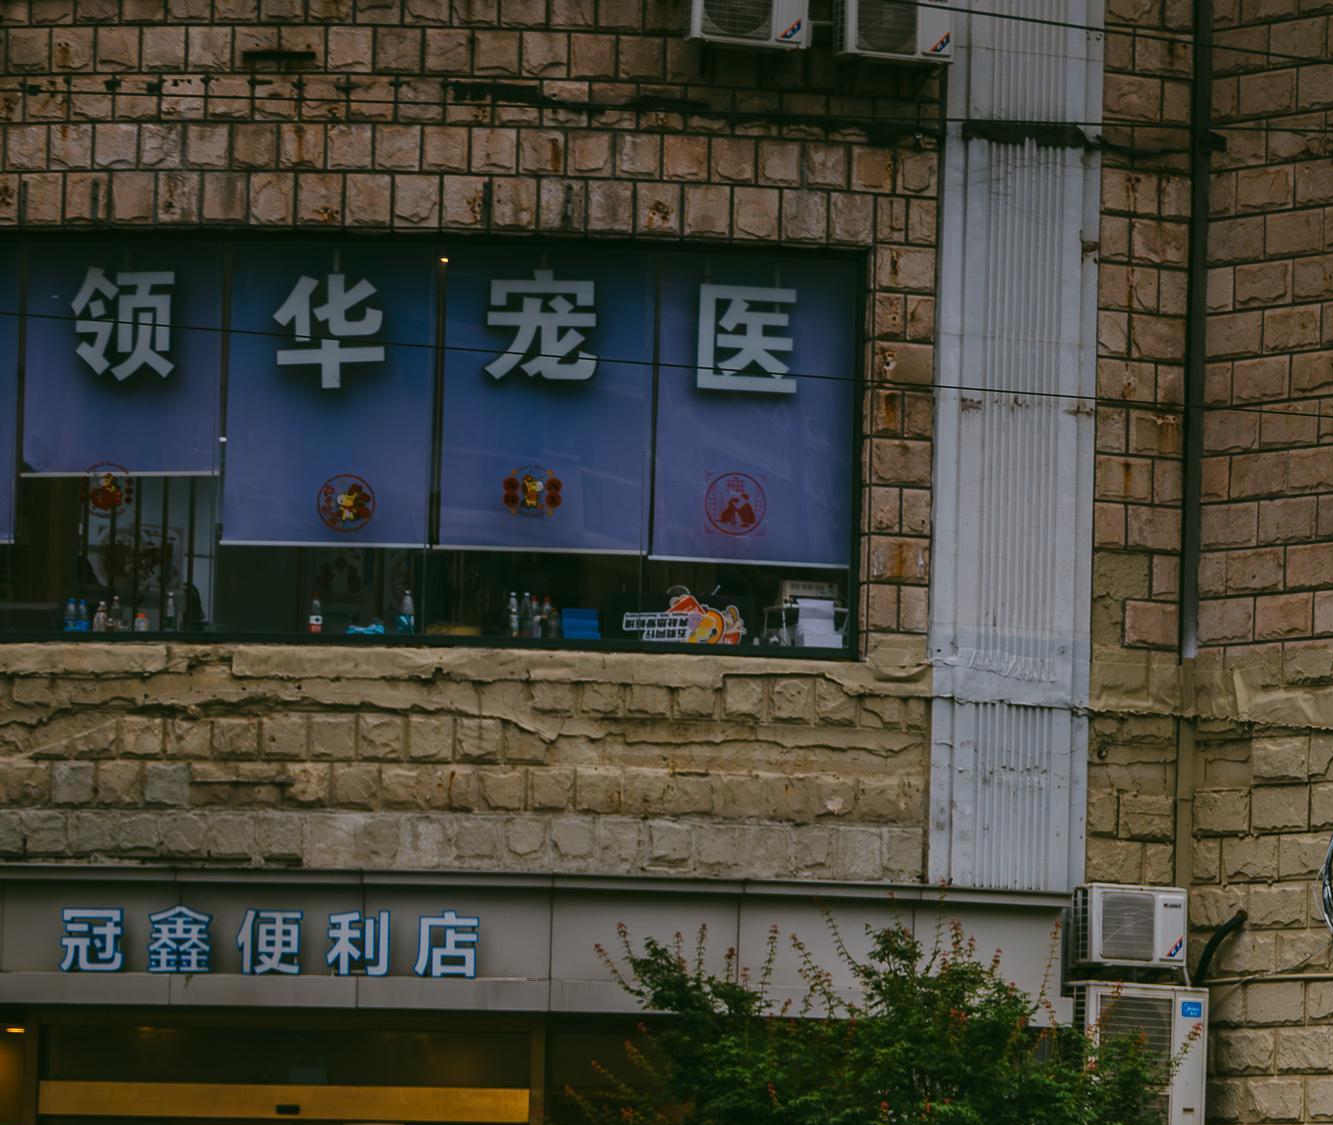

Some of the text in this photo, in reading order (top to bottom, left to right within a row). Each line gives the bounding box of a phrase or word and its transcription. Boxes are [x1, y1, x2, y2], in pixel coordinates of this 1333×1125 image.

[72, 267, 798, 394] 领华宠医
[60, 906, 481, 979] 冠鑫便利店
